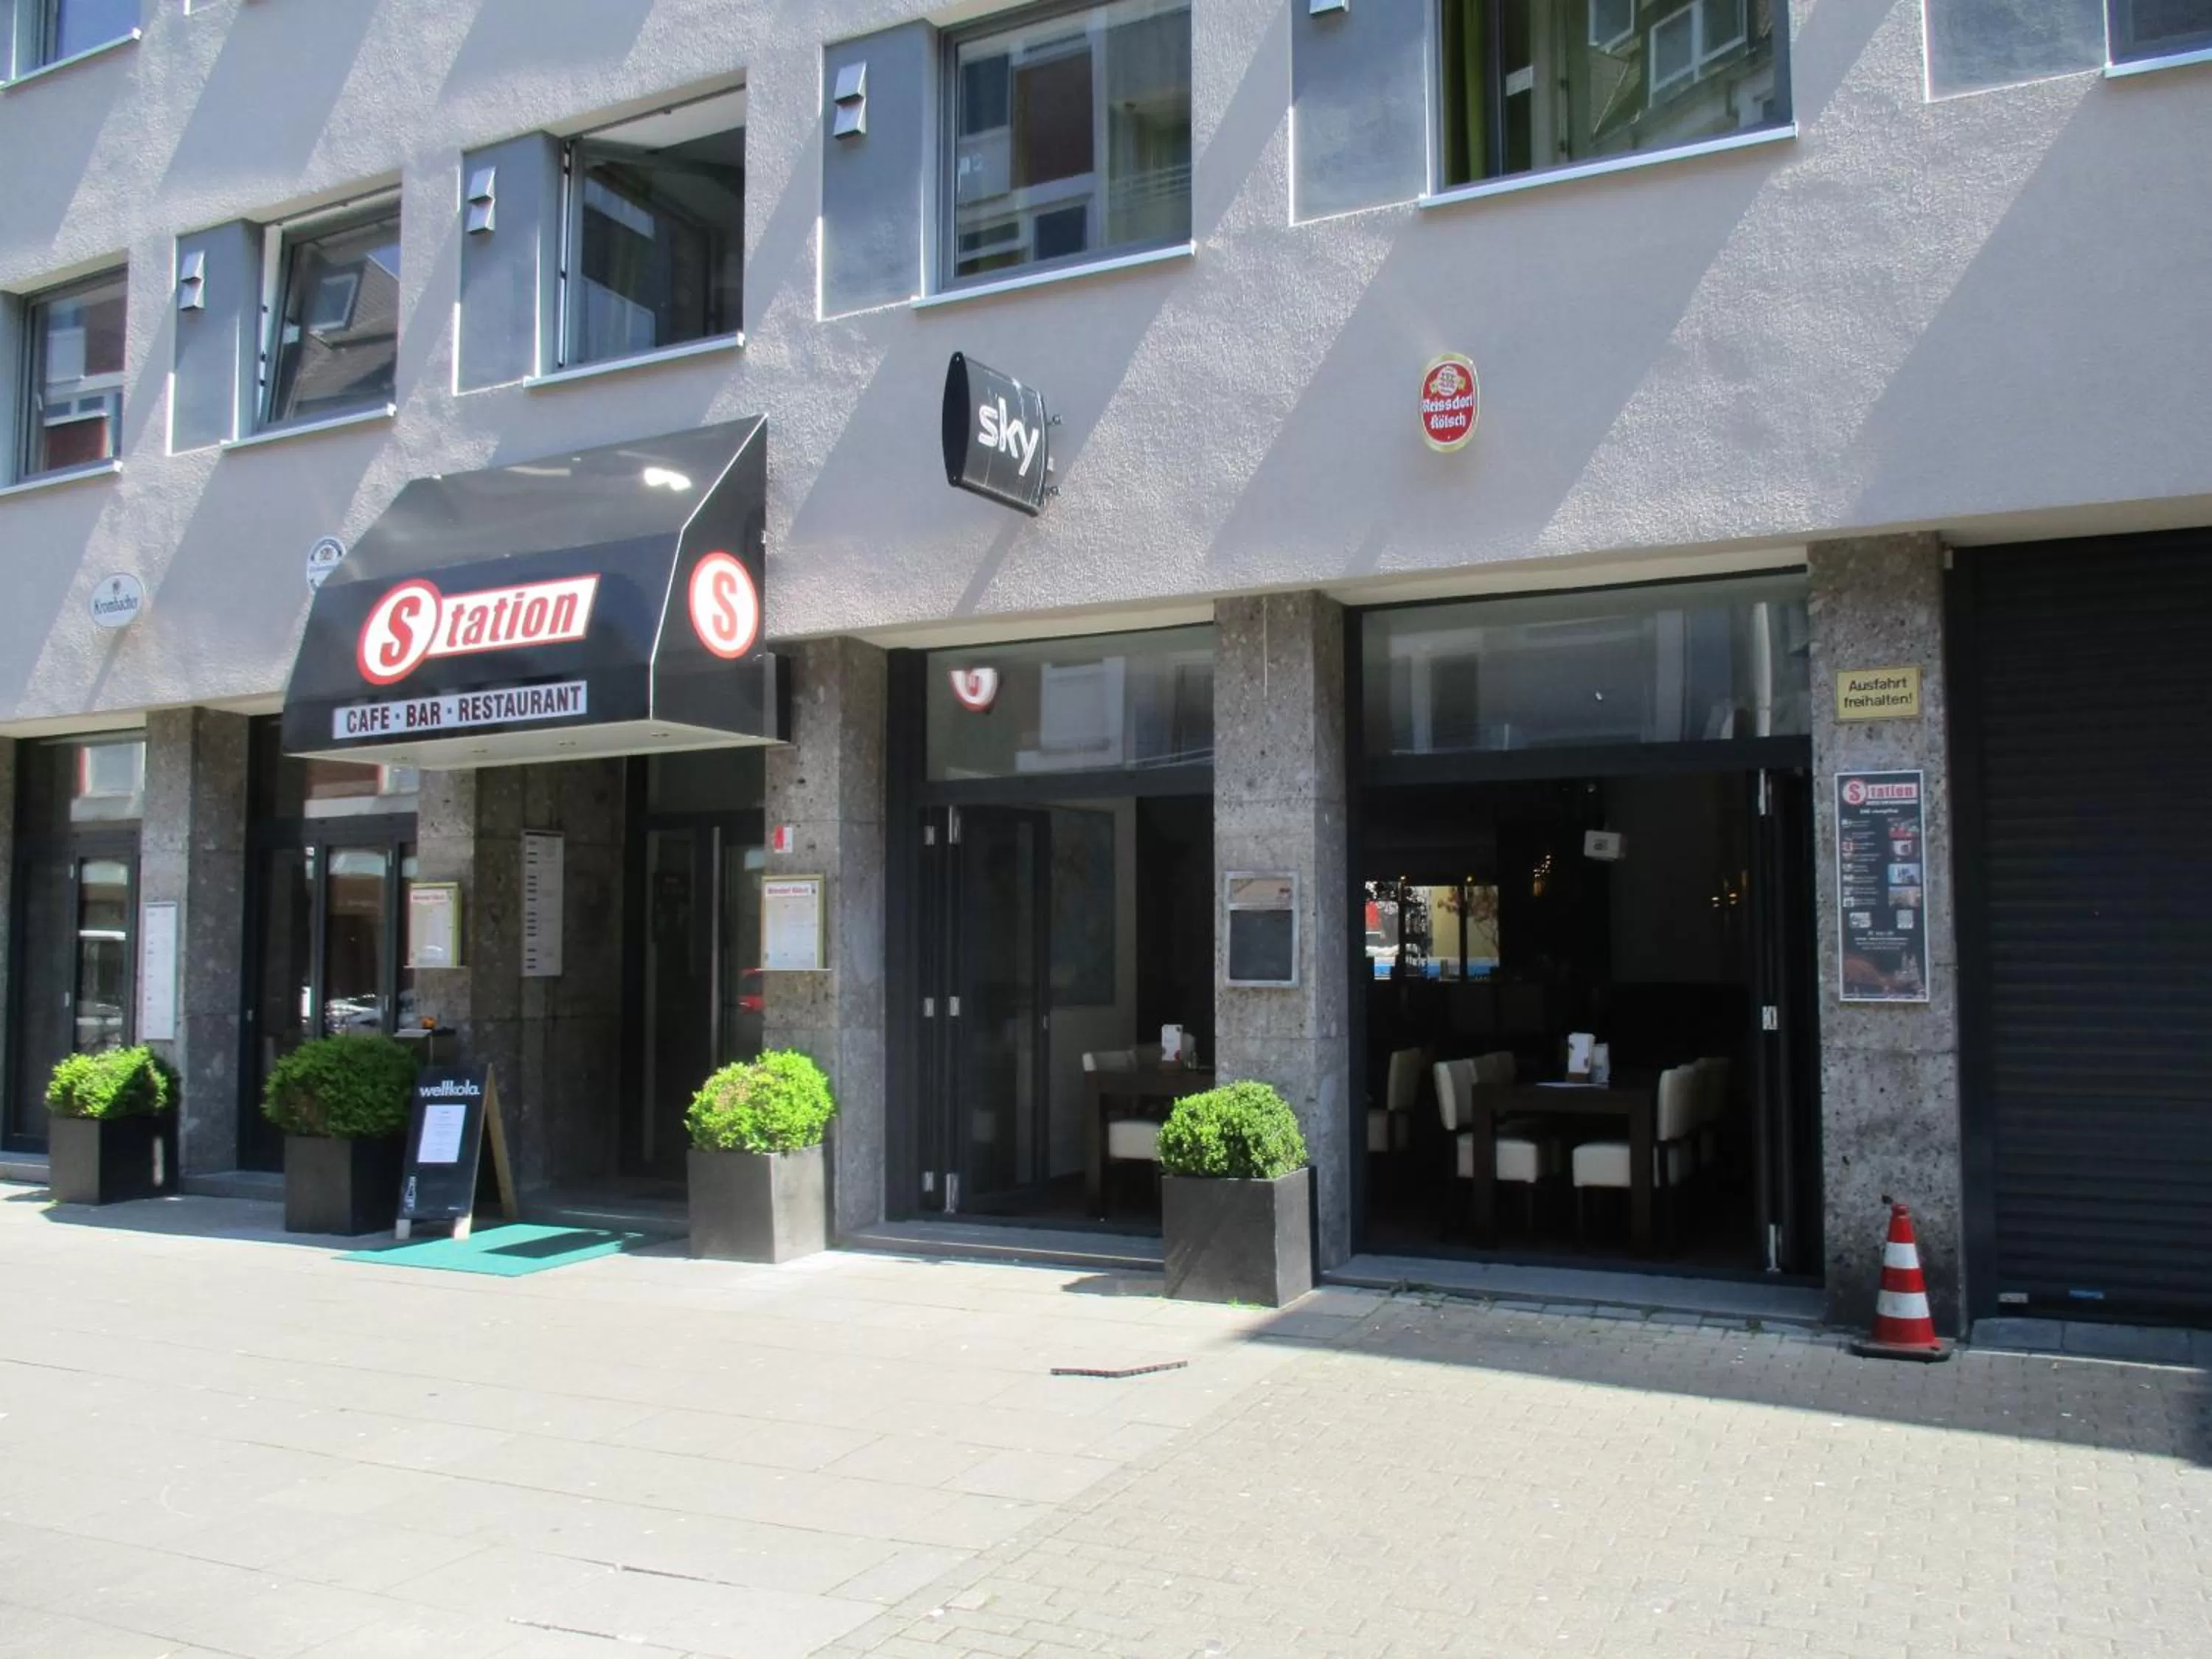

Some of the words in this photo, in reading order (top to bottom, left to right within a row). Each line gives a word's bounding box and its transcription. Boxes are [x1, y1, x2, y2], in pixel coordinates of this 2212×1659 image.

[978, 396, 1040, 476] sky
[380, 591, 579, 666] Station
[711, 571, 737, 641] S
[346, 711, 390, 734] CAFE
[406, 704, 442, 728] BAR
[458, 685, 582, 722] RESTAURANT
[1844, 692, 1913, 708] freihalten!
[1848, 676, 1907, 692] Ausfahrt
